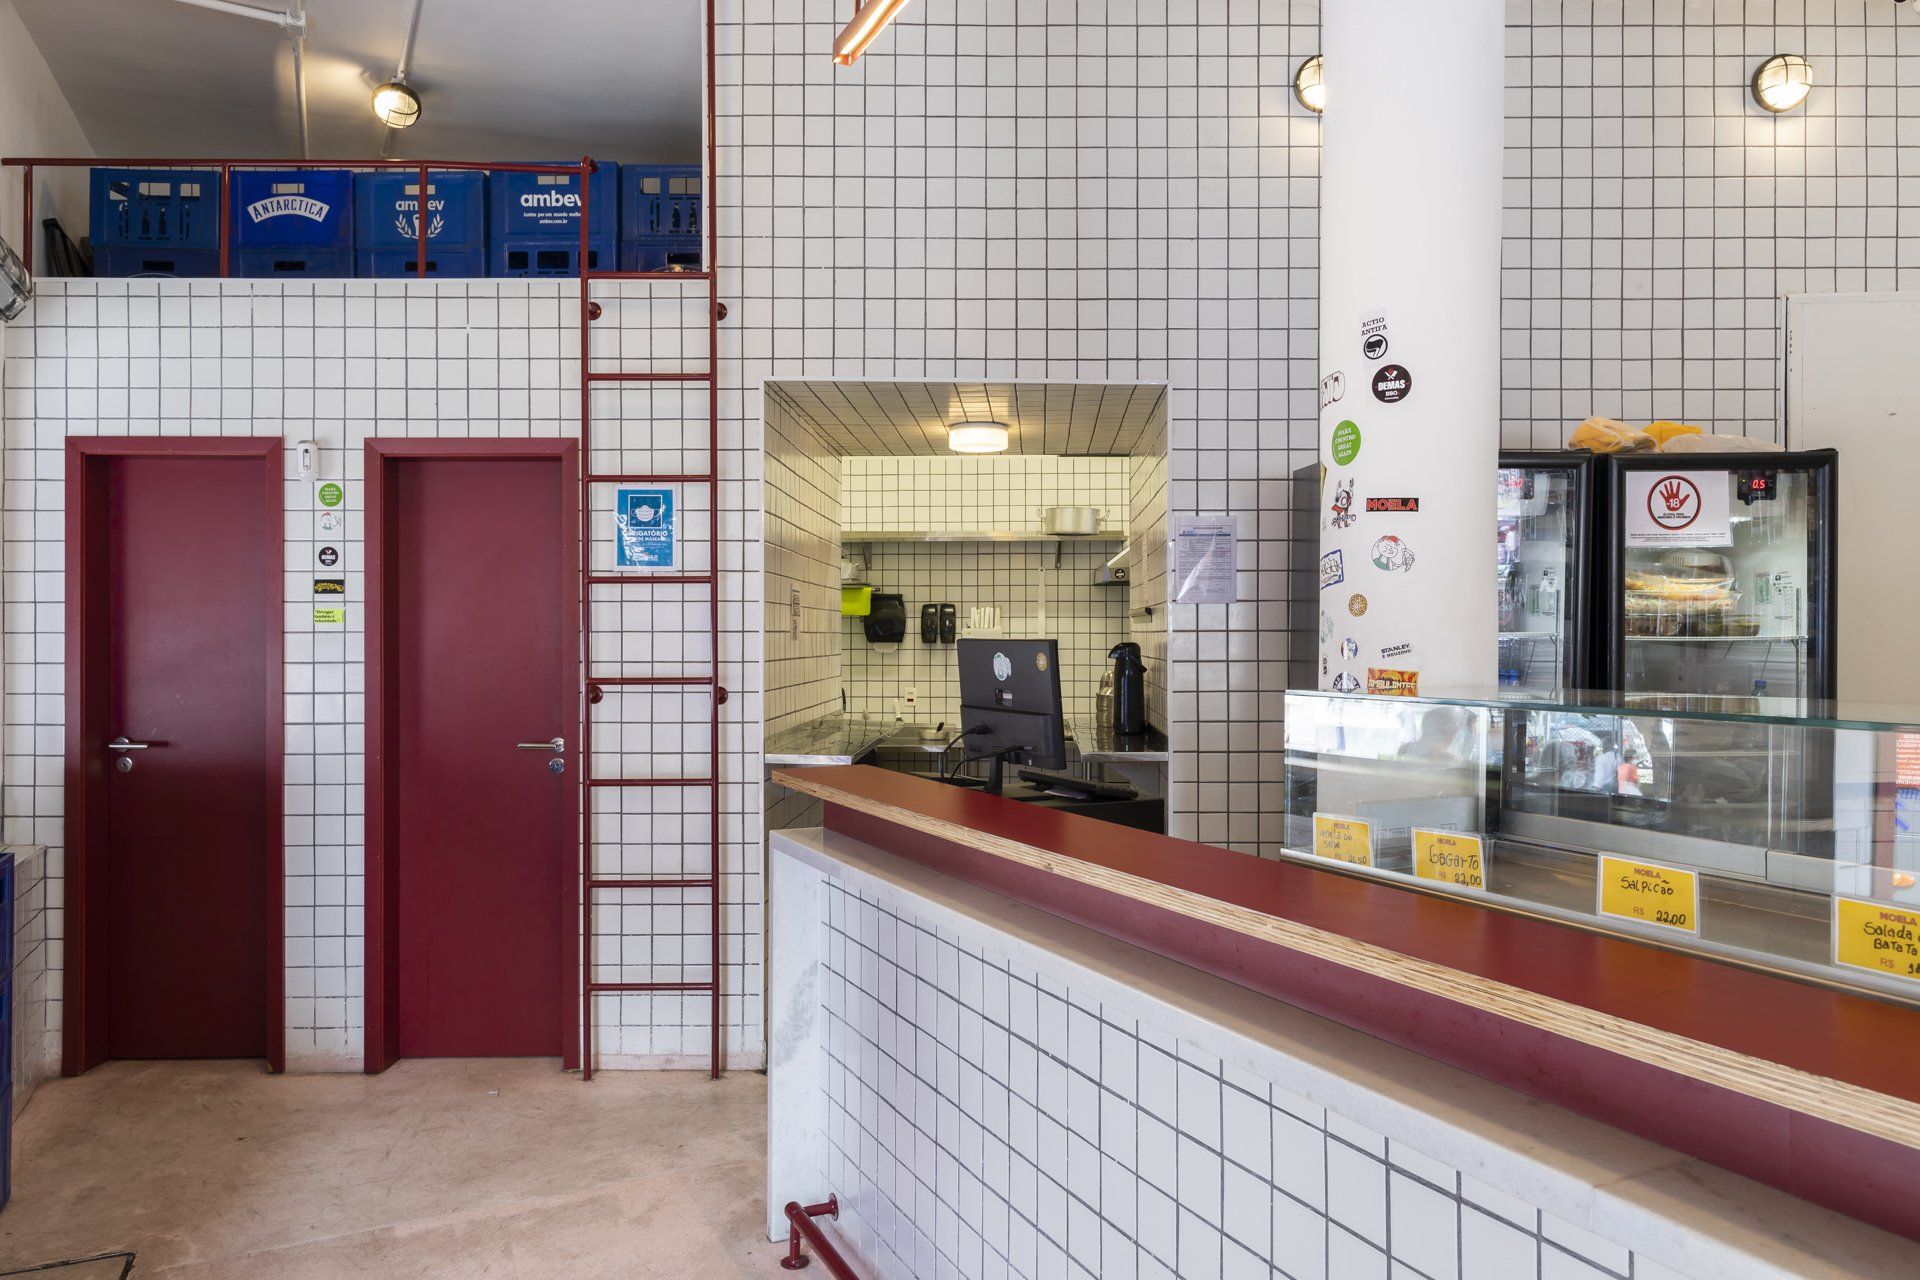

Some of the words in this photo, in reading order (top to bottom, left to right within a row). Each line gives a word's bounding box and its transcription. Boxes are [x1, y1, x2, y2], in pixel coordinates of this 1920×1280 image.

[252, 198, 324, 219] ANTARCTICA
[396, 200, 444, 210] amev
[1752, 480, 1766, 488] 0.5
[1366, 499, 1417, 510] MOELA
[1380, 643, 1410, 654] STANLEY
[1437, 837, 1457, 846] MOELA
[1634, 868, 1661, 878] MOELA
[1880, 912, 1917, 926] MOELA
